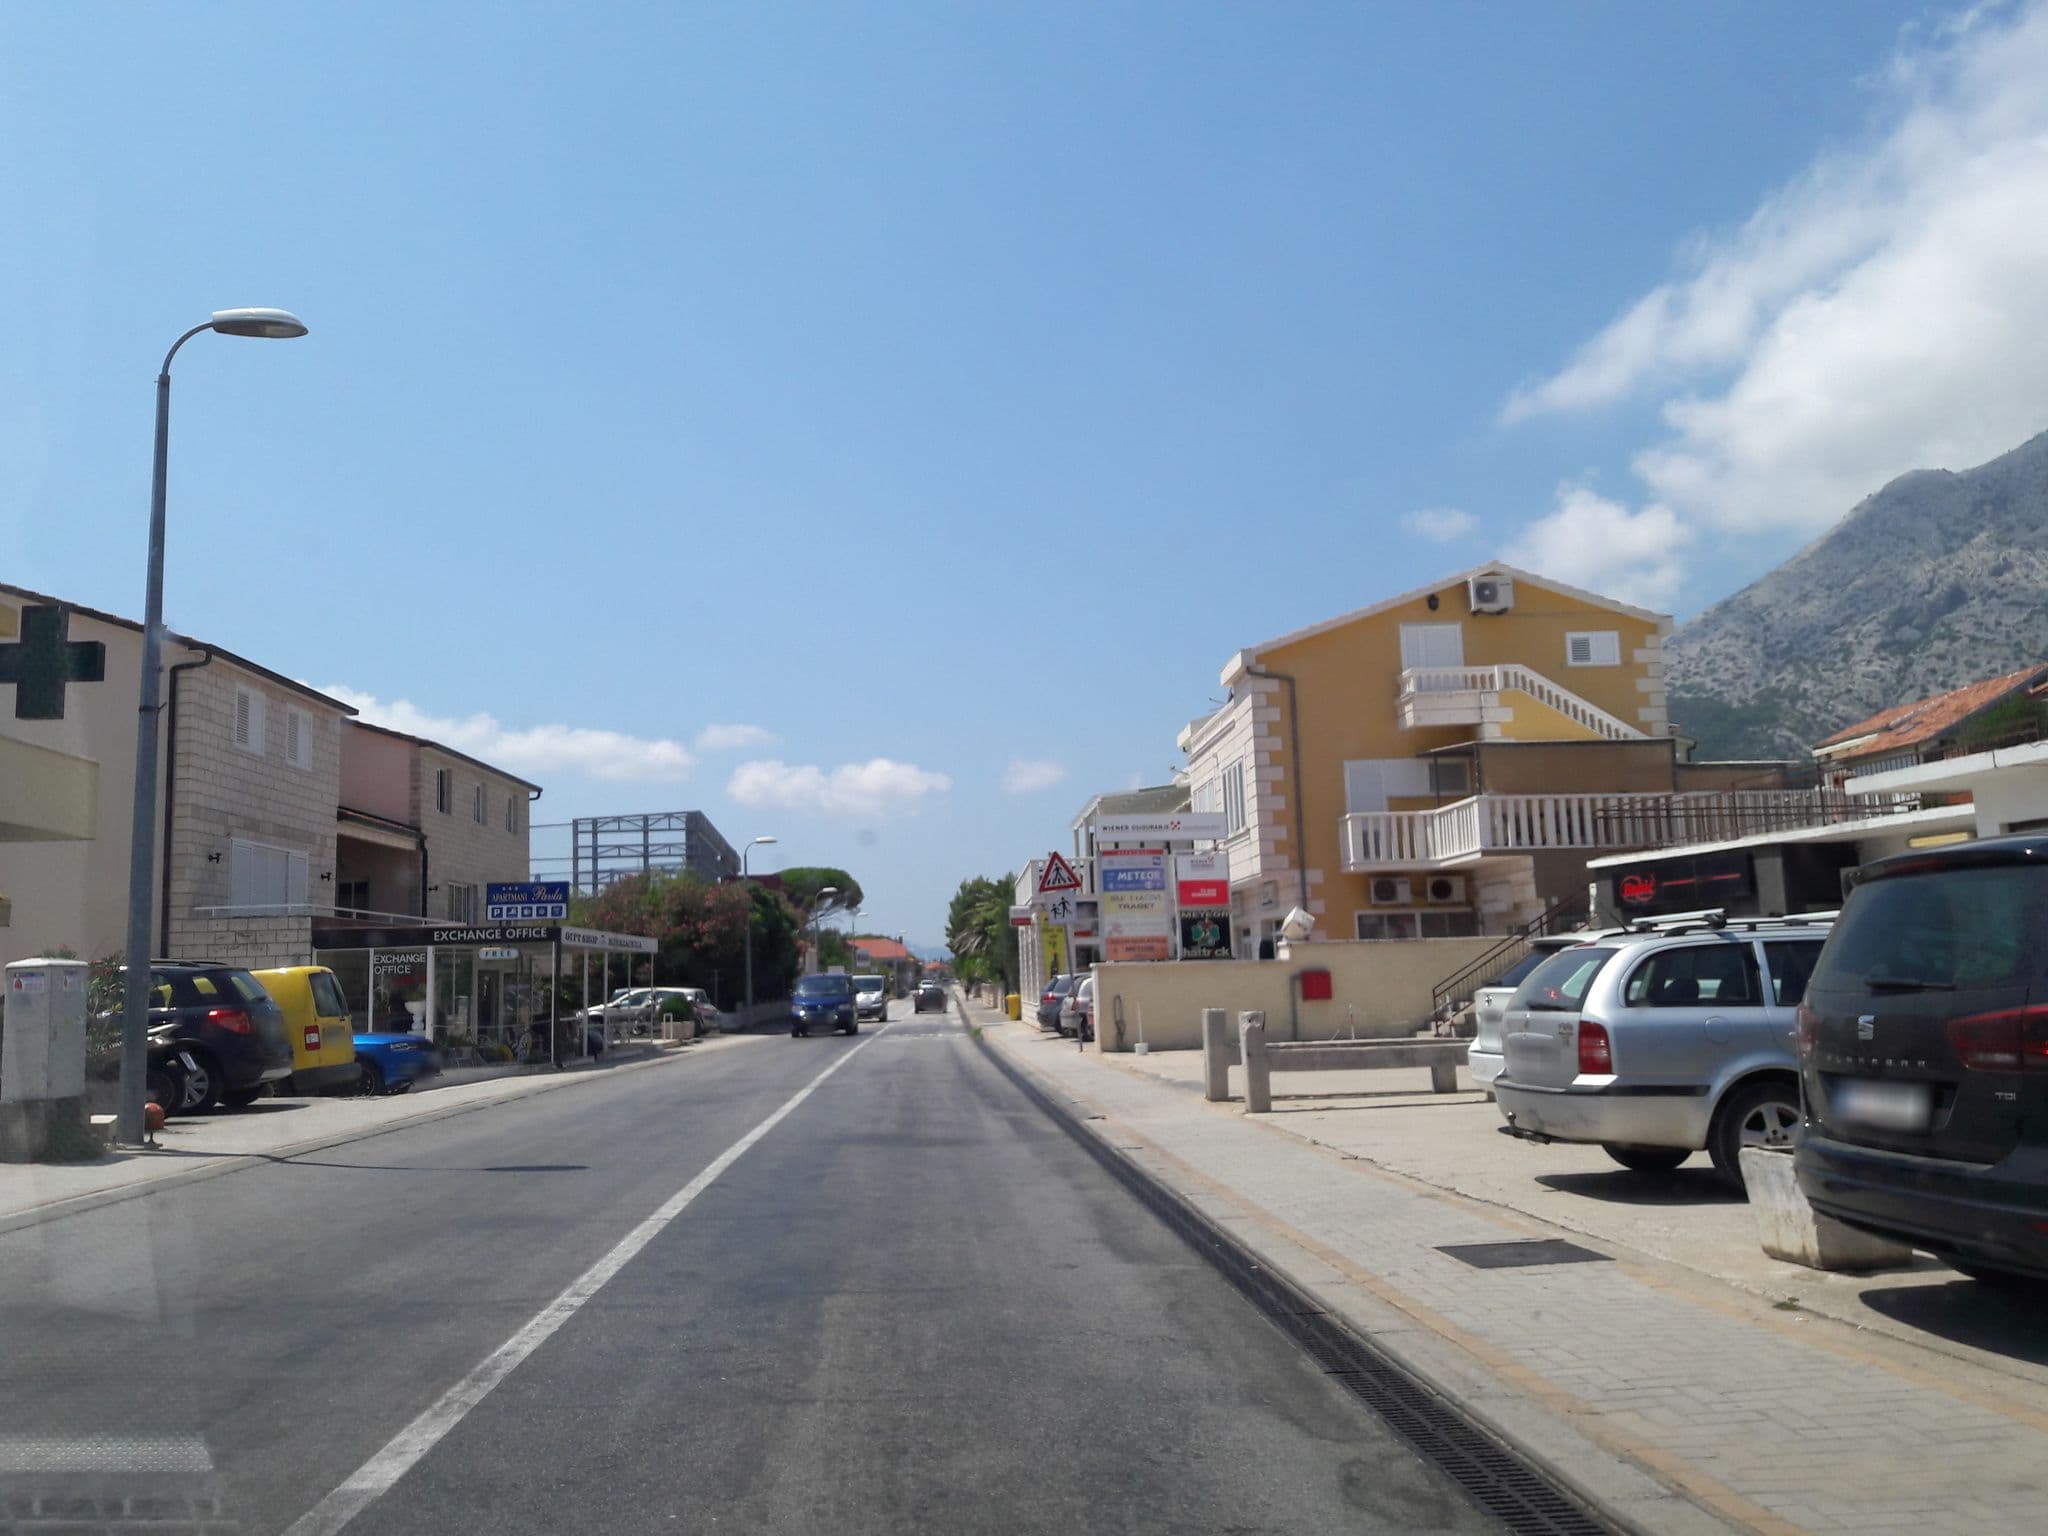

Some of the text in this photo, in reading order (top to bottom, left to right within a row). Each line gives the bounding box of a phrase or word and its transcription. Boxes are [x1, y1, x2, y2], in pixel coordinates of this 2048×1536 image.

[1117, 871, 1161, 881] METEOR
[1181, 910, 1229, 918] METEOR
[433, 927, 548, 941] EXCHANGE OFFICE
[374, 953, 426, 964] EXCHANGE
[374, 965, 411, 975] OFFICE
